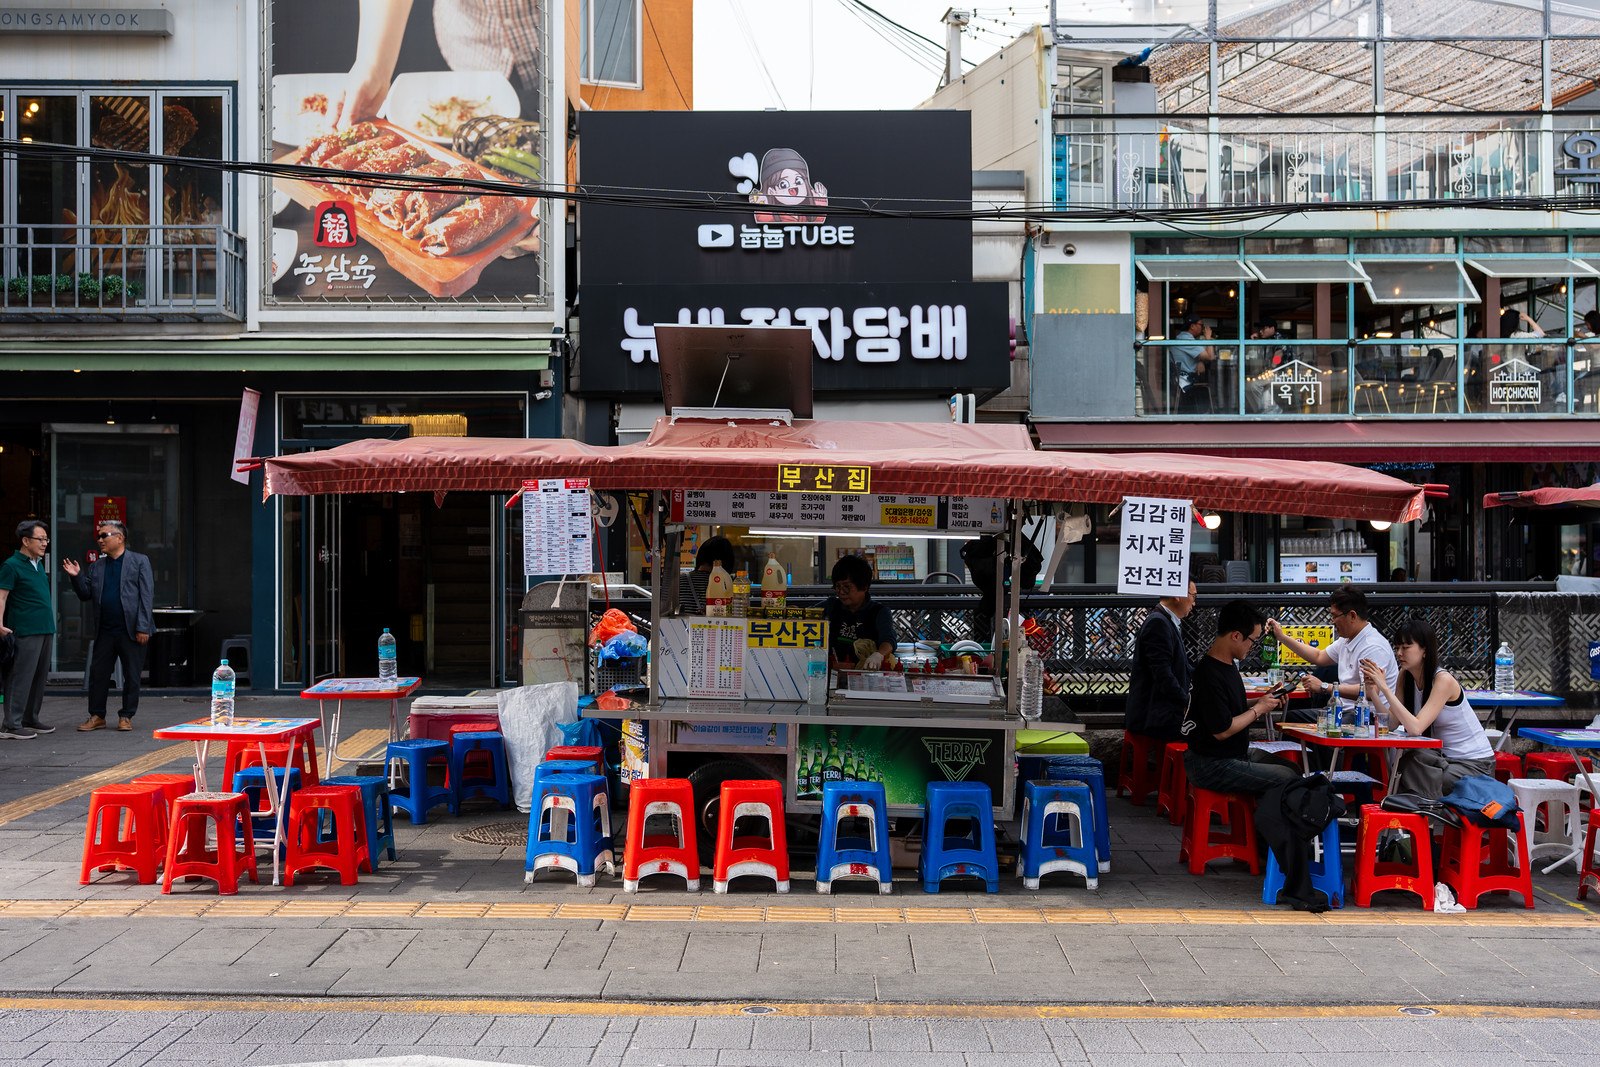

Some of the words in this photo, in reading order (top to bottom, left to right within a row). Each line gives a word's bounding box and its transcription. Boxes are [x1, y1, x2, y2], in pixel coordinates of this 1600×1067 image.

[294, 252, 376, 289] 종삼육
[1278, 384, 1316, 406] 옥상
[782, 467, 866, 491] 부산집
[1123, 503, 1146, 586] 김치전
[1144, 504, 1167, 586] 감자전
[1166, 506, 1186, 588] 해물파전
[748, 622, 825, 647] 부산집
[928, 742, 986, 765] TERRA
